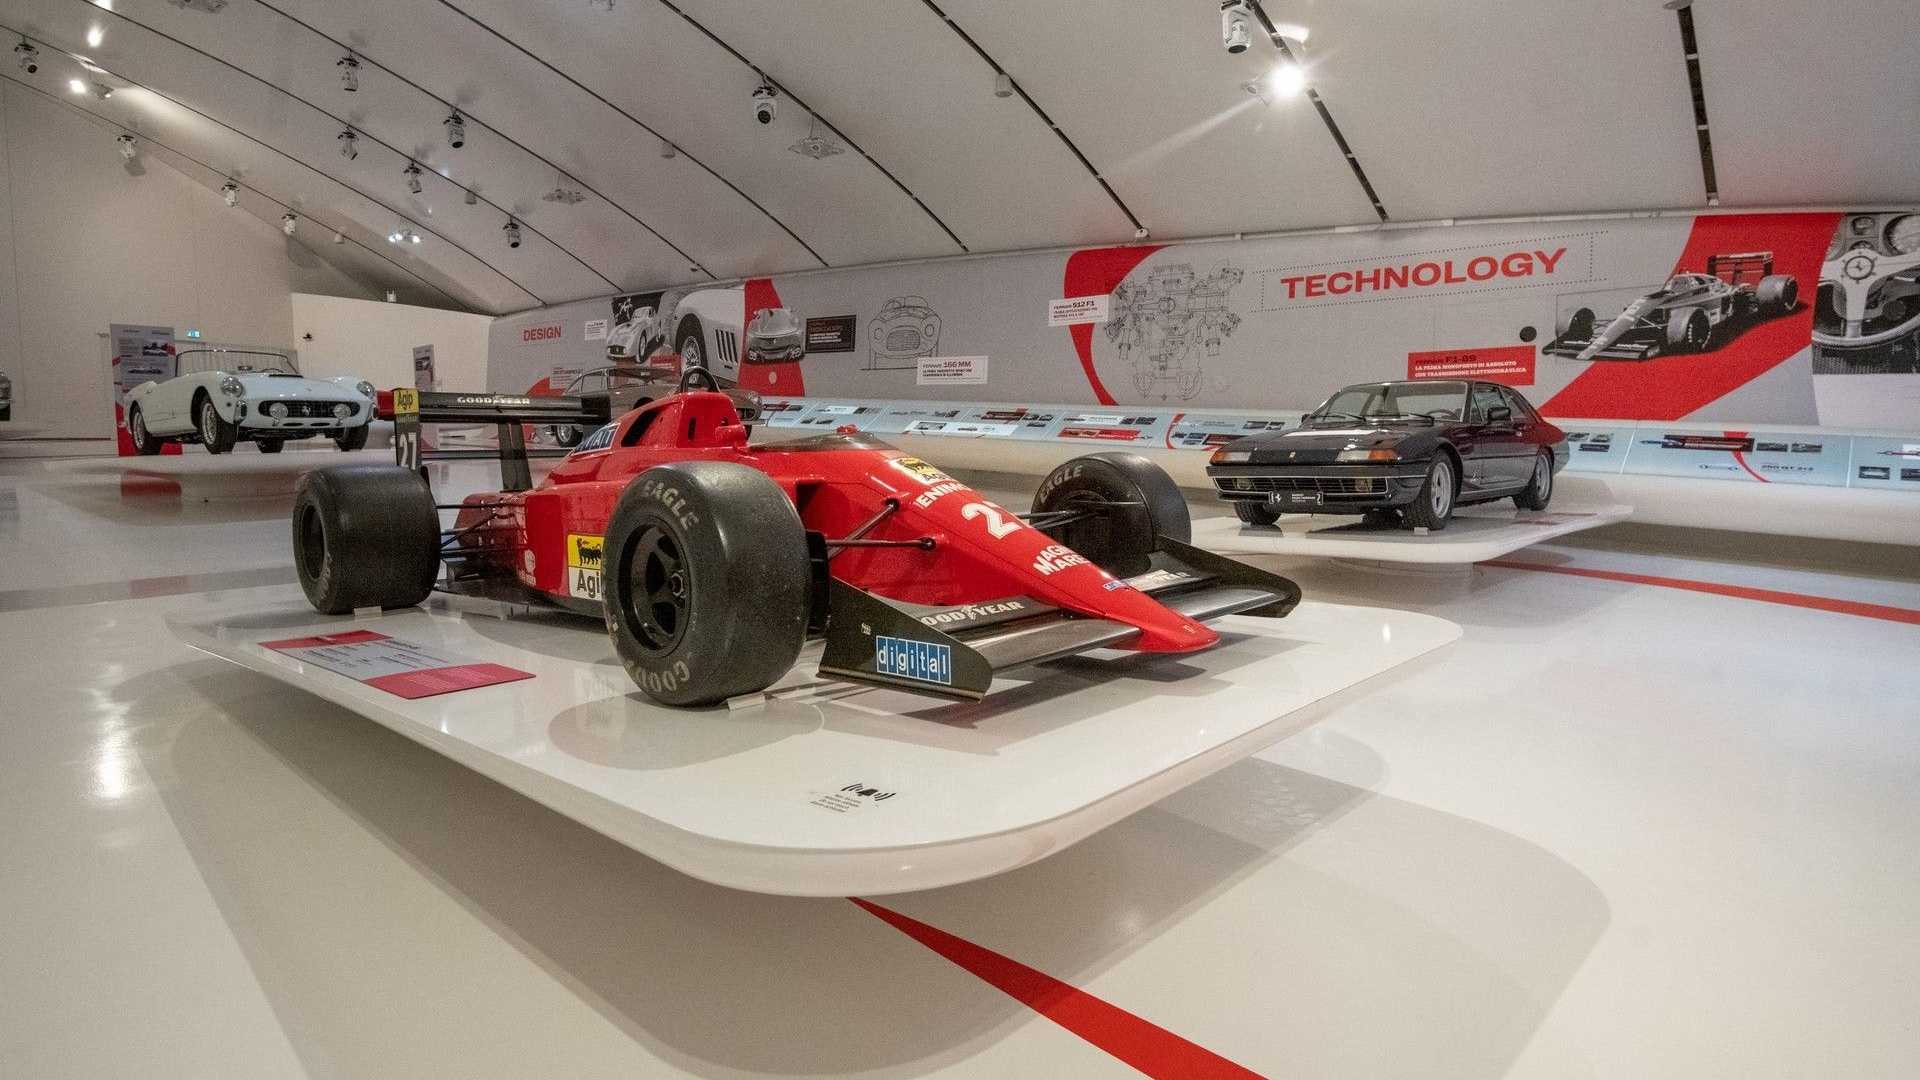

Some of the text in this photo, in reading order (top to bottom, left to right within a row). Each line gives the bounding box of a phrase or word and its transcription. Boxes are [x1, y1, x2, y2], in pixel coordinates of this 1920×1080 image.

[1280, 247, 1568, 300] TECHNOLOGY
[523, 326, 562, 341] DESIGN
[456, 396, 530, 404] GOODYEAR
[400, 431, 417, 470] 27
[641, 480, 700, 531] EAGLE
[962, 501, 1032, 540] 2
[576, 569, 601, 599] Agi
[920, 601, 1025, 627] OODYEAR
[878, 645, 947, 676] digital
